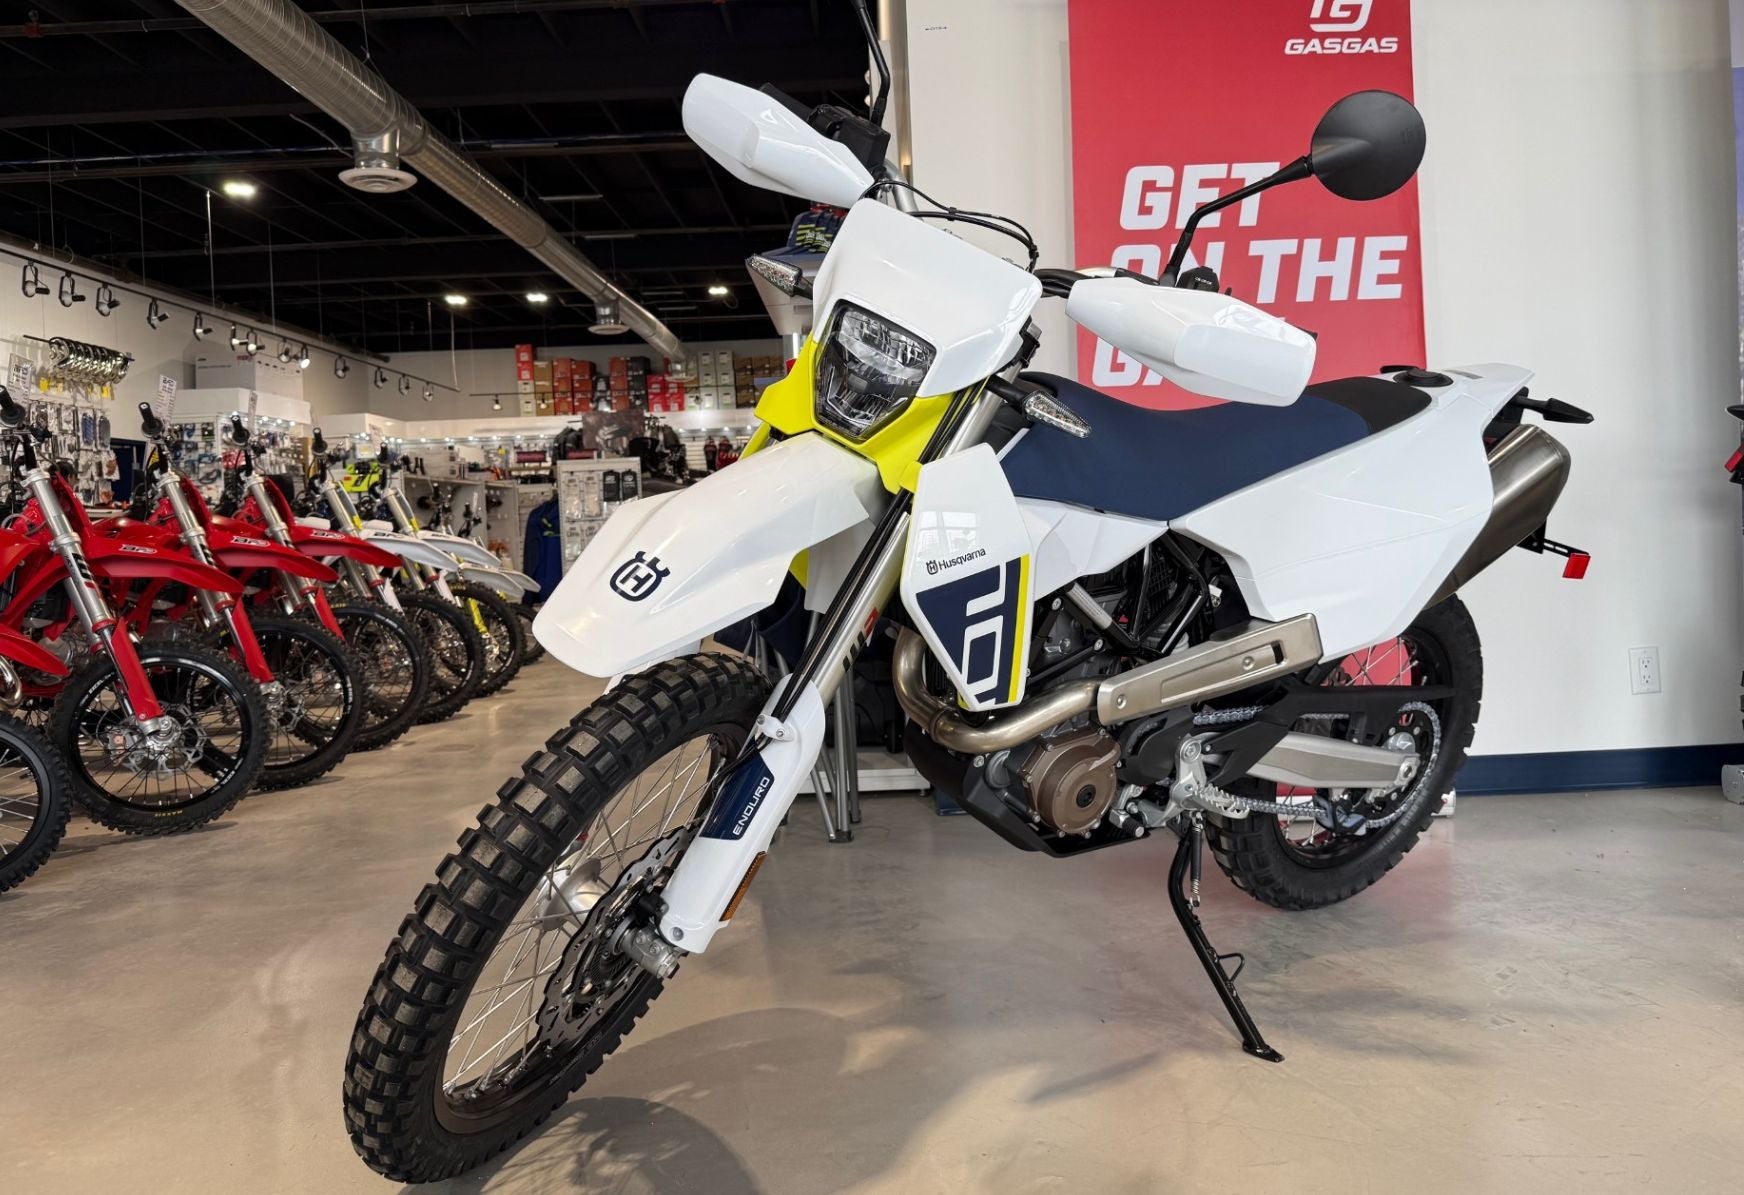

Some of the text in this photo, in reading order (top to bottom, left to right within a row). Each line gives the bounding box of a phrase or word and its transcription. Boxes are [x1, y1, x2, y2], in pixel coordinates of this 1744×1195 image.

[1284, 37, 1399, 54] GASGAS
[1119, 161, 1281, 231] GET
[1247, 235, 1408, 304] THE
[938, 548, 987, 571] Husqvarna
[732, 776, 770, 836] ENDURO
